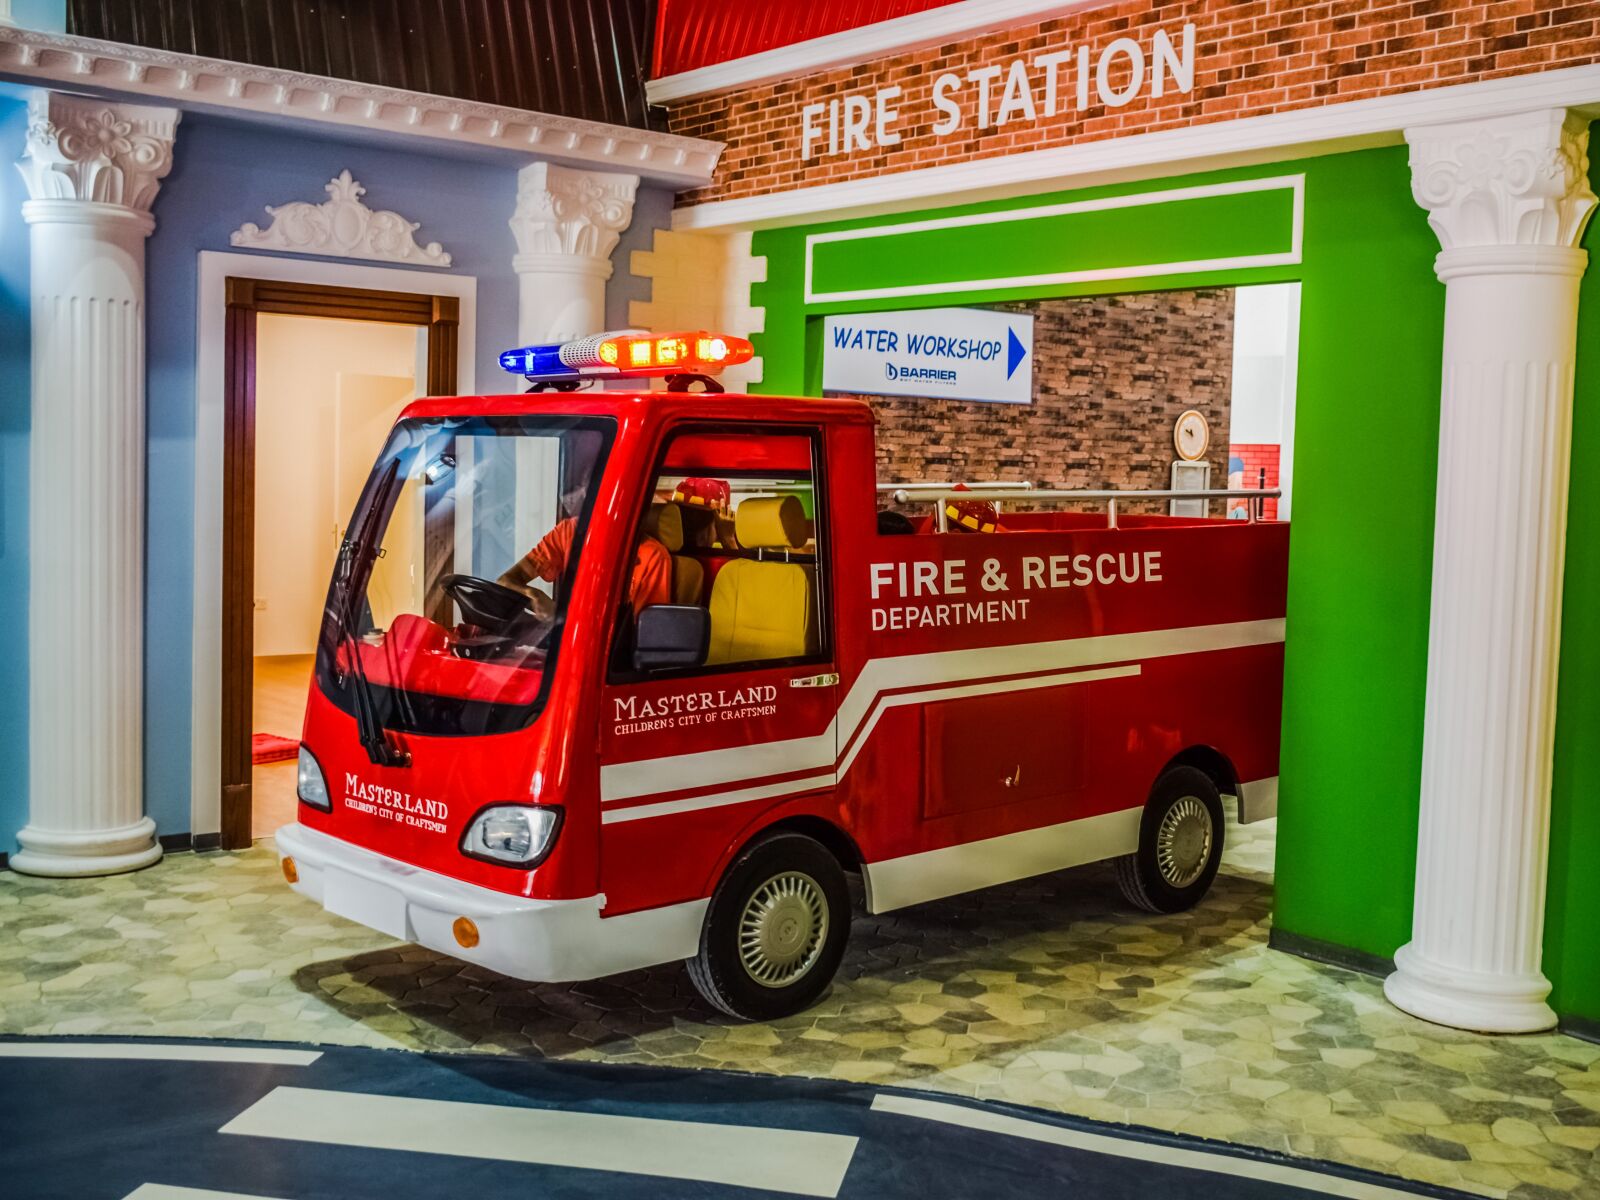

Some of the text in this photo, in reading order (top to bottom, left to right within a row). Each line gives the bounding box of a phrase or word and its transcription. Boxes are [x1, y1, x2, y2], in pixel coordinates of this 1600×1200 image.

[801, 23, 1197, 161] FIRE STATION
[834, 326, 1002, 361] WATER WORKSHOP
[900, 367, 957, 380] BARRIER
[870, 551, 1163, 599] FIRE & RESCUE
[871, 599, 1030, 631] DEPARTMENT
[678, 713, 701, 727] CITY
[705, 711, 718, 723] OF
[721, 704, 776, 722] CRAFTSMEN
[379, 807, 393, 820] CITY
[395, 812, 404, 823] OF
[406, 815, 447, 833] CRAFTSMEN
